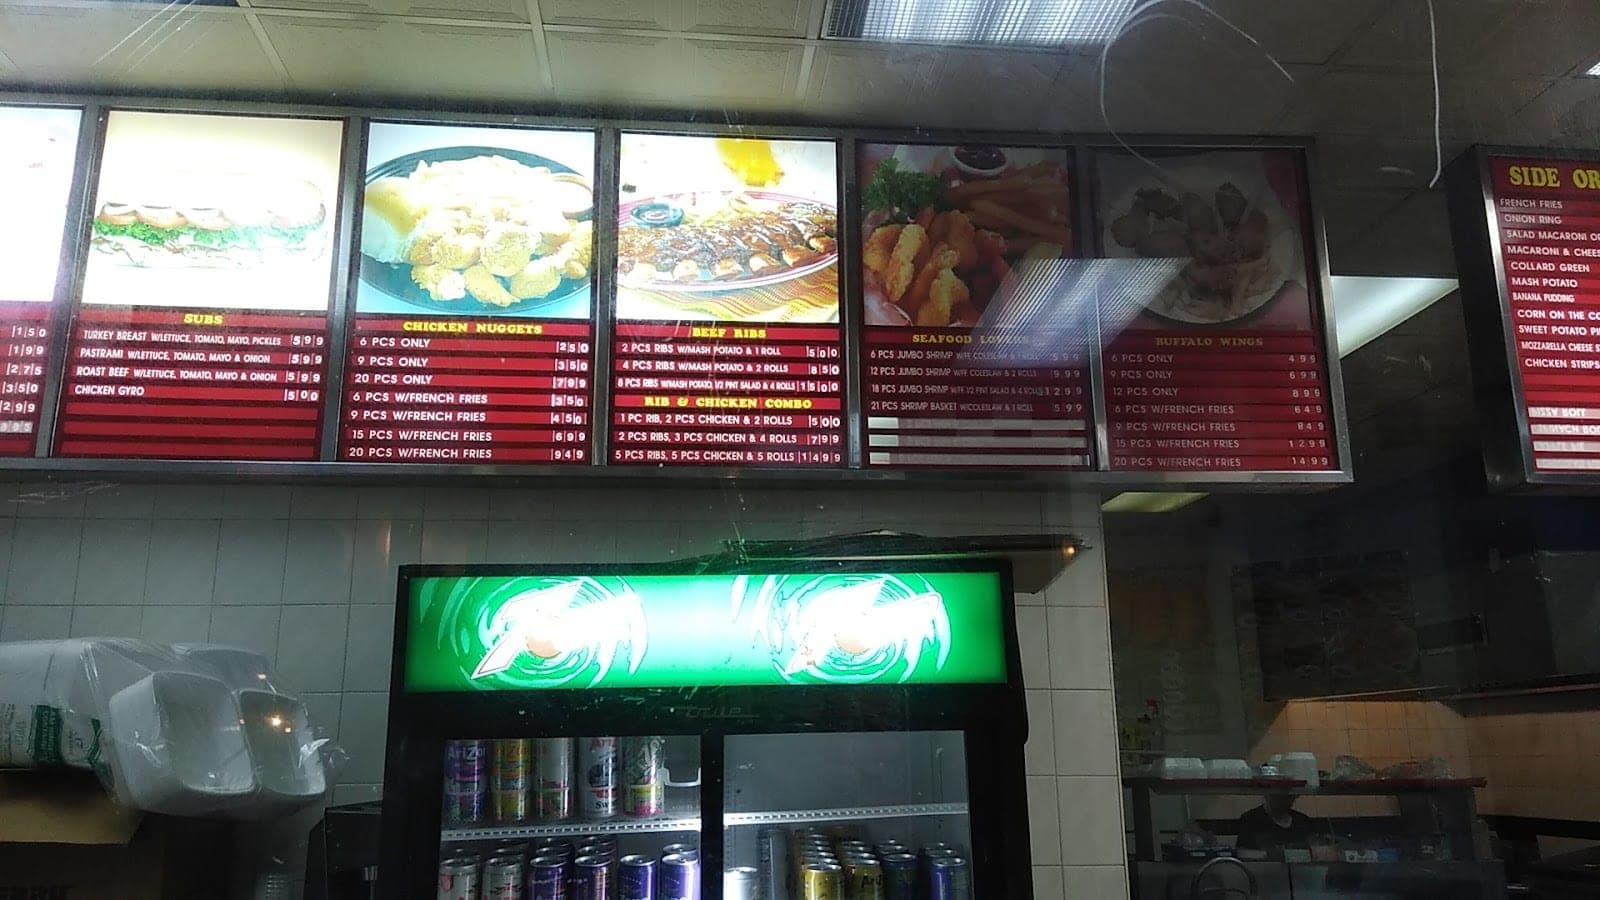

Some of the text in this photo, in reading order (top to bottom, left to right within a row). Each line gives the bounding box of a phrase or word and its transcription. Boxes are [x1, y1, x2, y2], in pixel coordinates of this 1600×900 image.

[1509, 166, 1560, 187] SIDE
[1501, 199, 1562, 209] FRENCH FRIES
[1504, 215, 1562, 225] ONION RING
[1507, 230, 1587, 241] SALAD MACARONI
[1508, 246, 1571, 256] MACARONI &
[1511, 262, 1589, 273] COLLARD GREEN
[1512, 278, 1577, 288] MASH POTATO
[184, 313, 223, 325] SUBS
[1518, 310, 1585, 320] CORN ON THE
[403, 322, 543, 334] CHICKEN NUGGETS
[692, 328, 766, 338] BEEF RIBS
[1519, 325, 1587, 335] SWEET POTATO
[84, 330, 113, 340] TURKEY
[117, 331, 146, 341] BREAST
[252, 337, 280, 345] PICKLES
[360, 337, 367, 346] 6
[372, 338, 395, 346] PCS
[401, 338, 430, 348] ONLY
[912, 334, 972, 343] SEAFOOD
[1156, 337, 1263, 346] BUFFALO WINGS
[622, 344, 627, 352] 2
[632, 344, 650, 352] PCS
[1522, 341, 1593, 352] MOZZARELLA CHEESE
[80, 348, 124, 359] PASTRAMI
[209, 353, 232, 362] MAYO
[244, 355, 270, 363] ONION
[1147, 355, 1174, 363] ONLY
[358, 356, 364, 364] 9
[370, 357, 393, 366] PCS
[399, 357, 428, 367] ONLY
[623, 361, 628, 369] 4
[633, 361, 651, 369] PCS
[656, 362, 674, 370] RIBS
[714, 364, 744, 372] POTATO
[764, 364, 788, 372] ROLLS
[1525, 359, 1600, 369] CHICKEN STRIPS
[77, 367, 105, 376] ROAST
[109, 368, 129, 377] BEEF
[215, 372, 238, 380] MAYO
[250, 372, 277, 381] ONION
[871, 367, 951, 376] 12 PCS SHRIMP
[1146, 371, 1172, 379] ONLY
[355, 374, 369, 383] 20
[374, 375, 397, 384] PCS
[403, 375, 432, 384] ONLY
[75, 385, 115, 395] CHICKEN
[118, 386, 144, 396] GYRO
[1113, 388, 1178, 396] 12 PCS ONLY
[353, 392, 360, 401] 6
[366, 393, 389, 401] PCS
[395, 393, 454, 404] W/FRENCH
[459, 394, 488, 404] FRIES
[644, 397, 812, 408] RIB & CHICKEN COMBO
[871, 402, 880, 410] 21
[882, 402, 898, 410] PCS
[1126, 405, 1146, 413] PCS
[1151, 405, 1205, 414] W/FRENCH
[1209, 406, 1234, 414] FRIES
[351, 411, 358, 419] 9
[363, 411, 386, 419] PCS
[393, 411, 452, 422] W/FRENCH
[457, 412, 486, 422] FRIES
[628, 414, 641, 423] PC
[675, 415, 694, 423] PCS
[699, 415, 739, 424] CHICKEN
[764, 417, 792, 425] ROLLS
[1127, 423, 1236, 431] PCS W/FRENCH FRIES
[353, 430, 363, 439] 15
[369, 431, 393, 440] PCS
[399, 431, 458, 441] W/FRENCH
[463, 432, 492, 441] FRIES
[628, 432, 647, 440] PCS
[684, 433, 702, 441] PCS
[706, 434, 746, 442] CHICKEN
[770, 434, 797, 443] ROLLS
[1130, 440, 1151, 448] PCS
[1156, 440, 1211, 448] W/FRENCH
[1214, 440, 1239, 448] FRIES
[350, 448, 363, 456] 20
[369, 448, 392, 457] PCS
[399, 448, 458, 458] W/FRENCH
[463, 449, 491, 458] FRIES
[625, 451, 643, 459] PCS
[681, 452, 700, 460] PCS
[704, 452, 743, 460] CHICKEN
[767, 453, 794, 461] ROLLS
[1115, 458, 1126, 466] 20
[1132, 458, 1152, 466] PCS
[1157, 458, 1212, 466] W/FRENCH
[1215, 458, 1241, 466] FRIES
